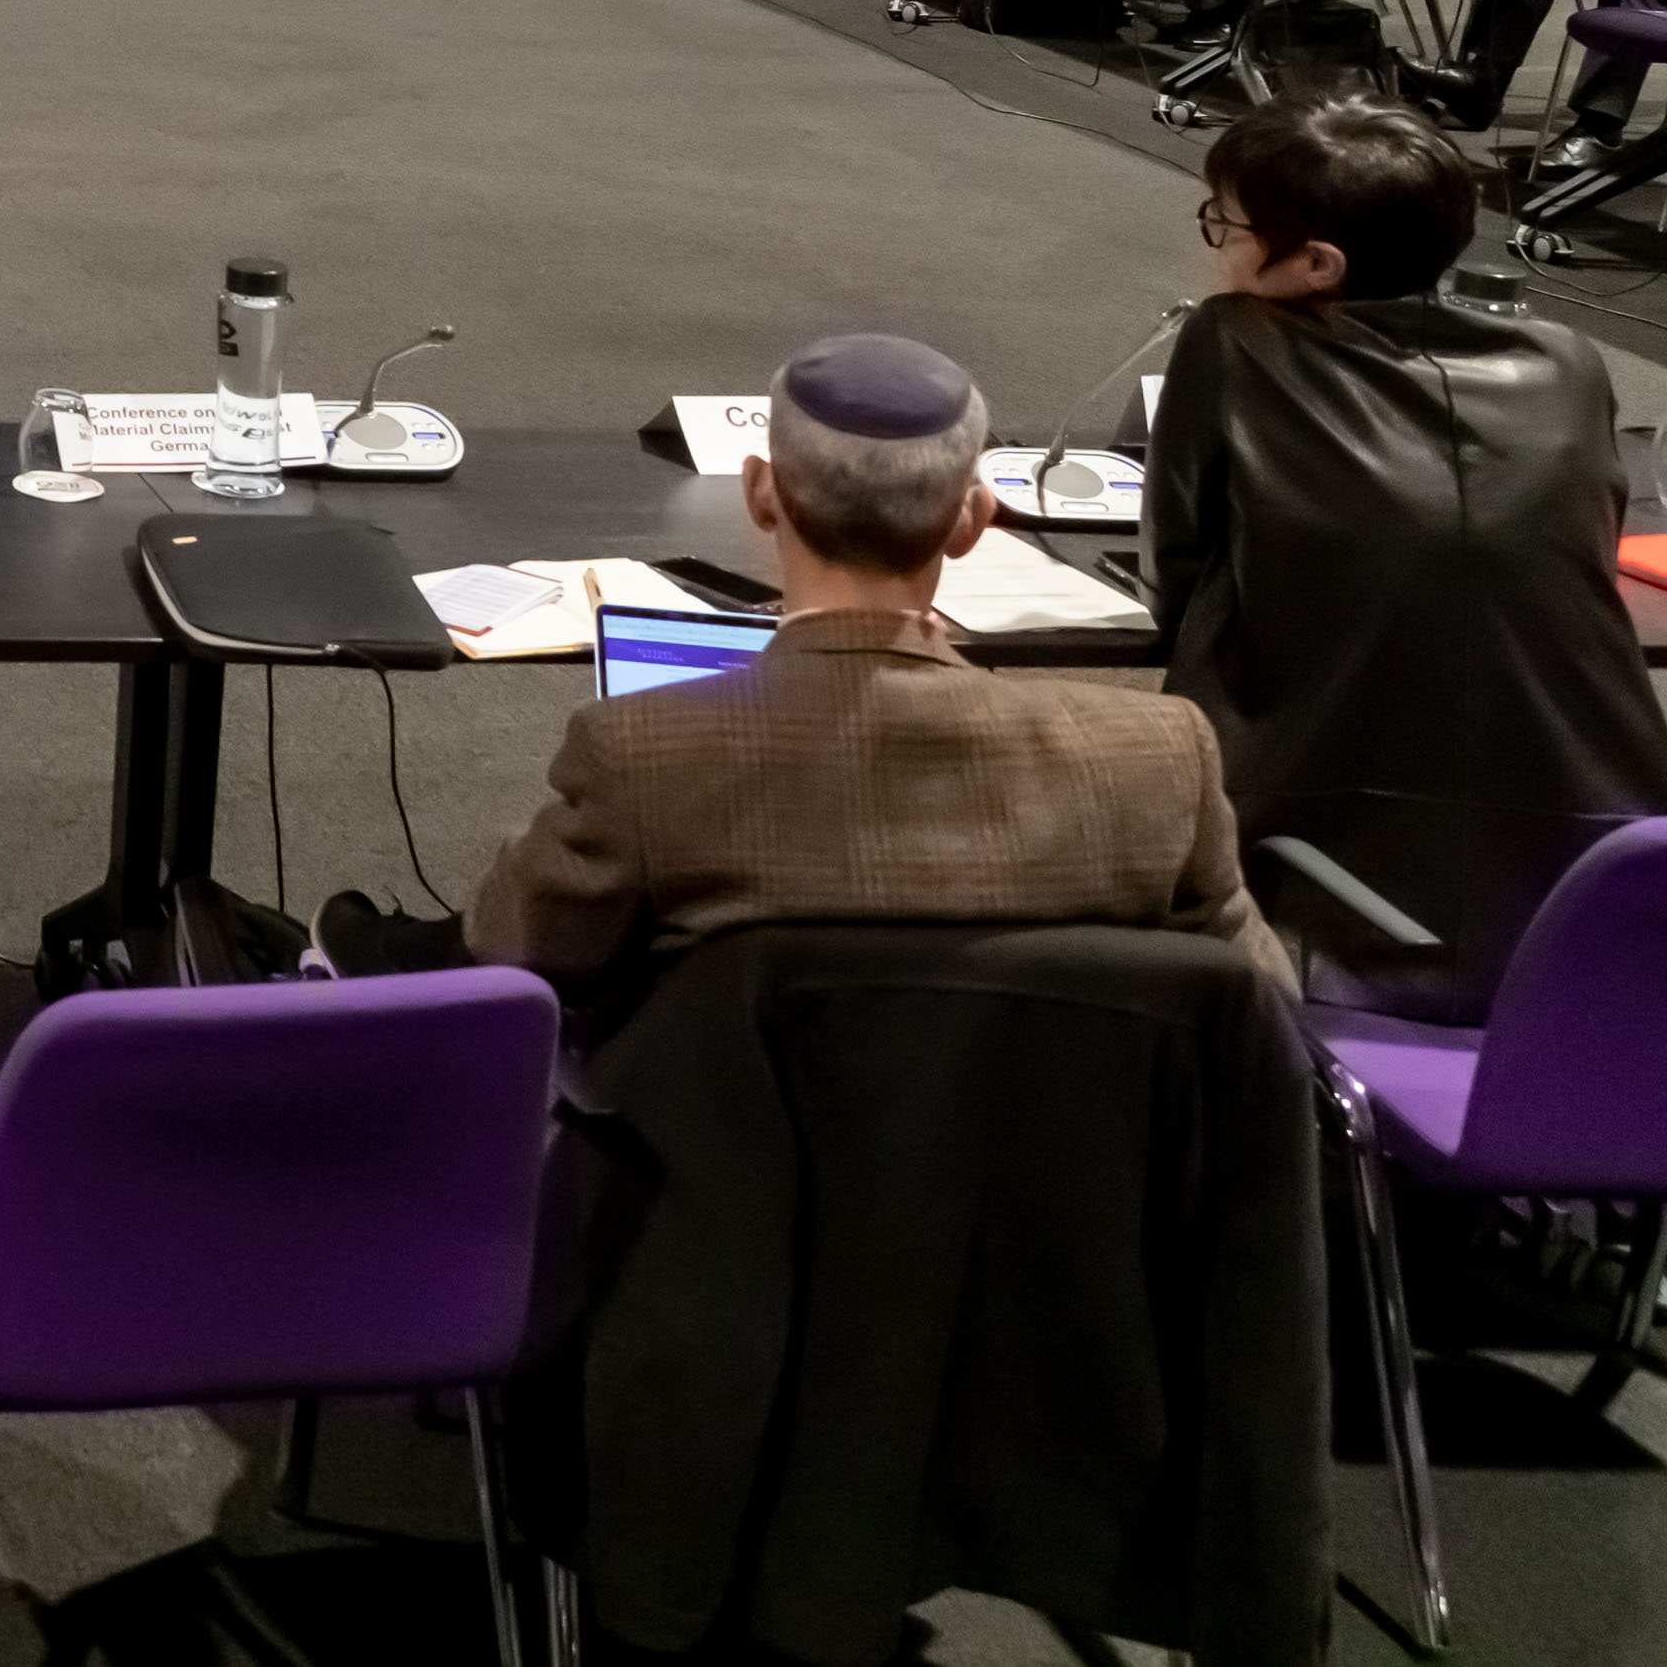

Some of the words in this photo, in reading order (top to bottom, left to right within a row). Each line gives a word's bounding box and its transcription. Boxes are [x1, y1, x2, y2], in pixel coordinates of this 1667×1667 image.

[88, 407, 187, 420] Conference
[194, 409, 216, 420] on
[150, 440, 209, 452] Germa
